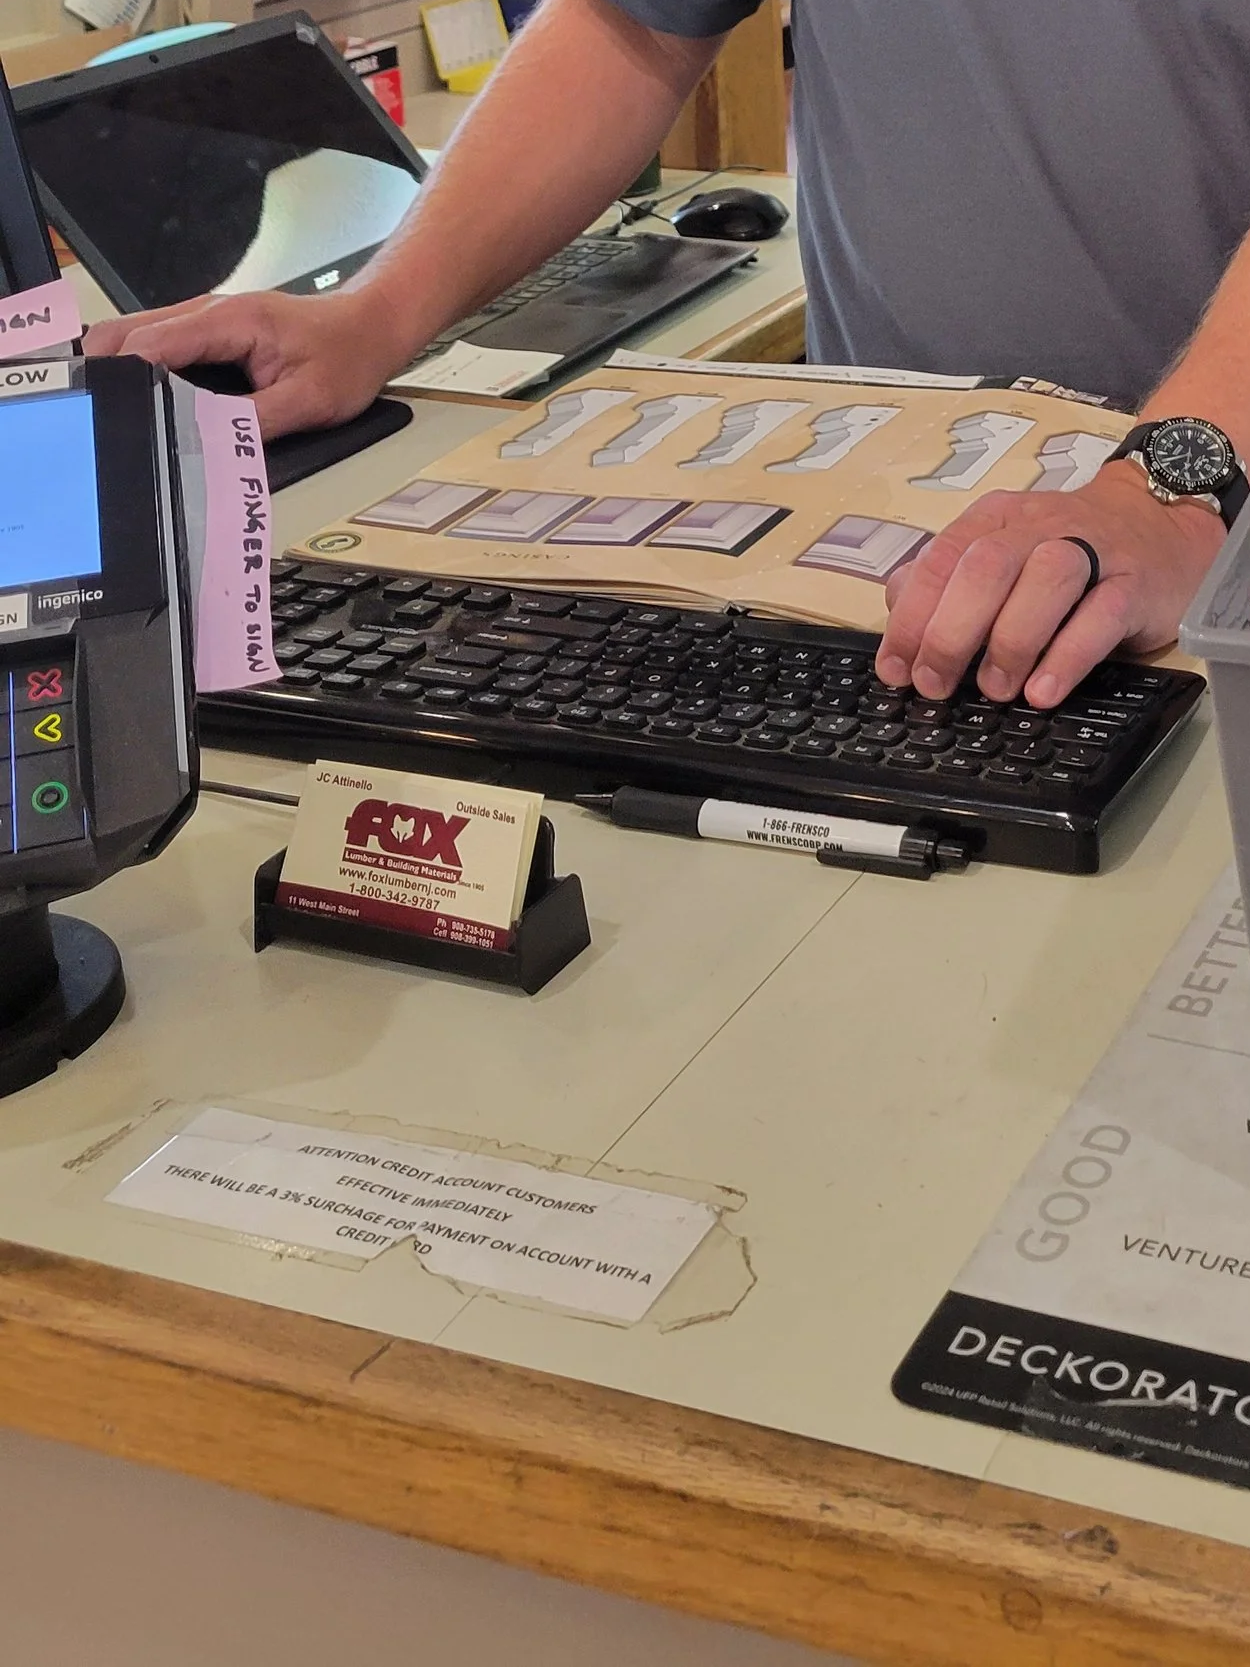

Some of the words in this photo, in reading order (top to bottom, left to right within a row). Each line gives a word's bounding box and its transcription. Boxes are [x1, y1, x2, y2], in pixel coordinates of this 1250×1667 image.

[231, 417, 256, 458] USE
[239, 477, 267, 574] FINGER
[38, 588, 104, 609] ingenico
[245, 584, 261, 613] TO
[246, 623, 270, 673] SIGN
[316, 771, 331, 783] JC
[332, 774, 373, 791] Attinello
[456, 801, 490, 819] Outside
[493, 809, 516, 824] Sales
[762, 817, 830, 838] 1-866-FRENSCO
[344, 851, 376, 865] Lumber
[378, 856, 384, 866] &
[387, 857, 419, 875] Building
[421, 866, 457, 882] Materials
[338, 866, 457, 900] www.foxlumbernj.com
[348, 882, 440, 911] 1-800-342-9787
[288, 895, 298, 906] 11
[299, 898, 318, 909] West
[318, 900, 337, 913] Main
[338, 903, 360, 917] Street
[433, 927, 448, 938] Cell
[437, 917, 447, 927] Ph
[297, 1144, 380, 1167] ATTENTION
[381, 1159, 433, 1183] CREDIT
[432, 1175, 505, 1193] ACCOUNT
[506, 1187, 598, 1215] CUSTOMERS
[1015, 1123, 1132, 1263] GOOD
[336, 1175, 415, 1204] EFFECTIVE
[411, 1196, 514, 1223] IMMEDIATELY
[164, 1165, 210, 1182] THERE
[210, 1174, 244, 1192] WILL
[245, 1183, 267, 1195] BE
[264, 1188, 278, 1198] A
[279, 1190, 303, 1203] 3%
[304, 1196, 384, 1224] SURCHAGE
[384, 1217, 417, 1231] FOR
[417, 1221, 487, 1246] PAYMENT
[490, 1239, 517, 1253] ON
[515, 1246, 595, 1270] ACCOUNT
[595, 1261, 642, 1281] WITH
[637, 1273, 652, 1285] A
[336, 1225, 393, 1246] CREDIT
